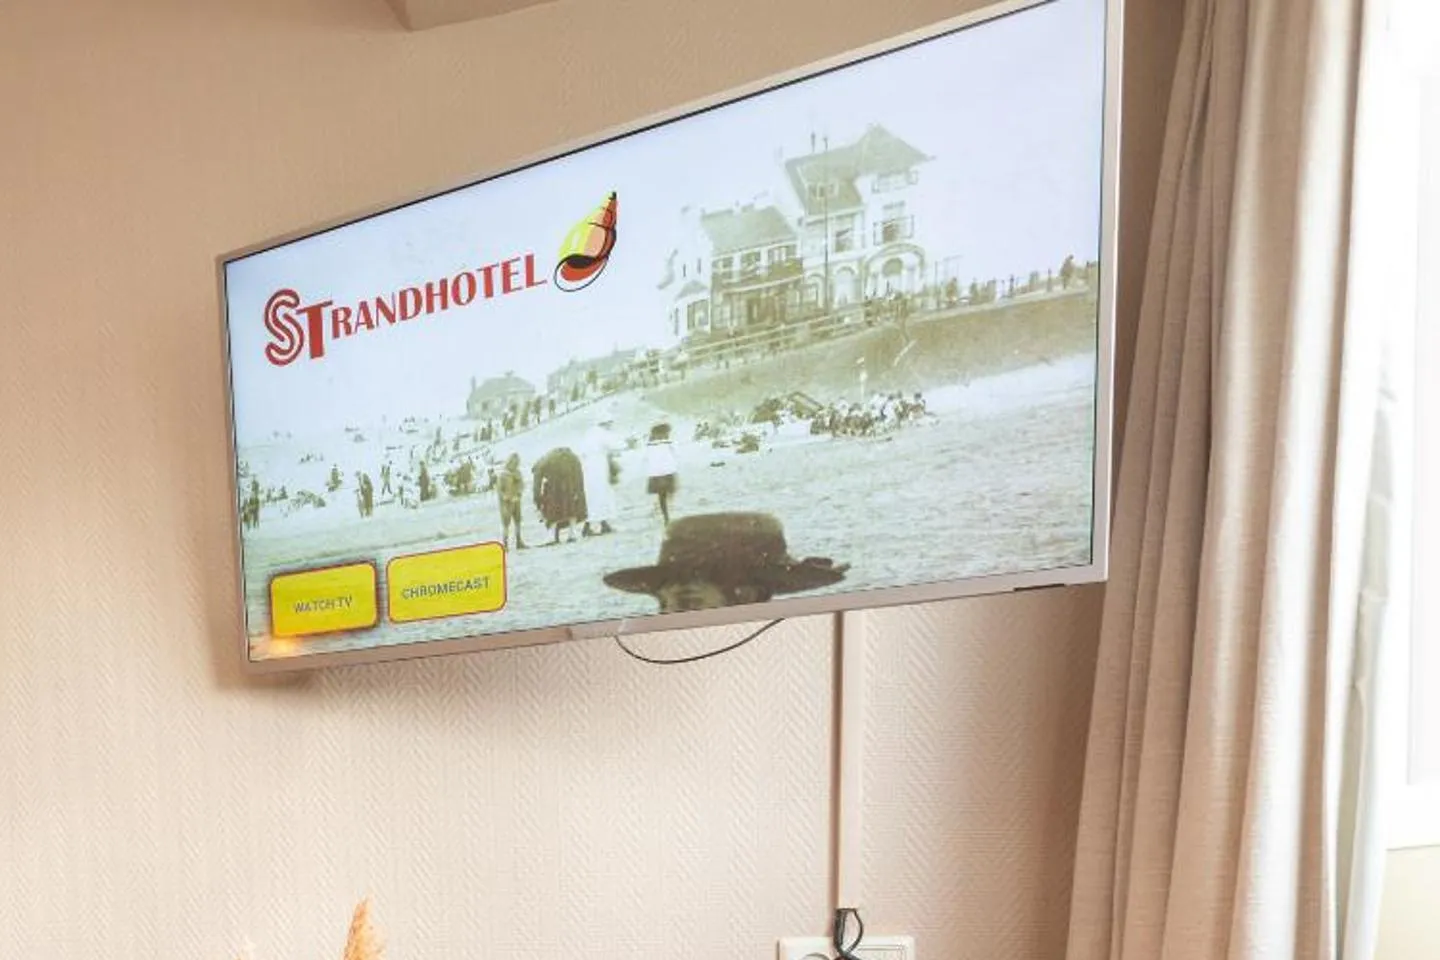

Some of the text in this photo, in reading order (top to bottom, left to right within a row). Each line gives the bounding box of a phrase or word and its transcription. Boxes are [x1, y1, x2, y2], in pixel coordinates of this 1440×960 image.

[264, 253, 548, 366] STRANDHOTEL
[401, 576, 490, 599] CHROMECAST
[293, 596, 353, 614] WATCH TV
